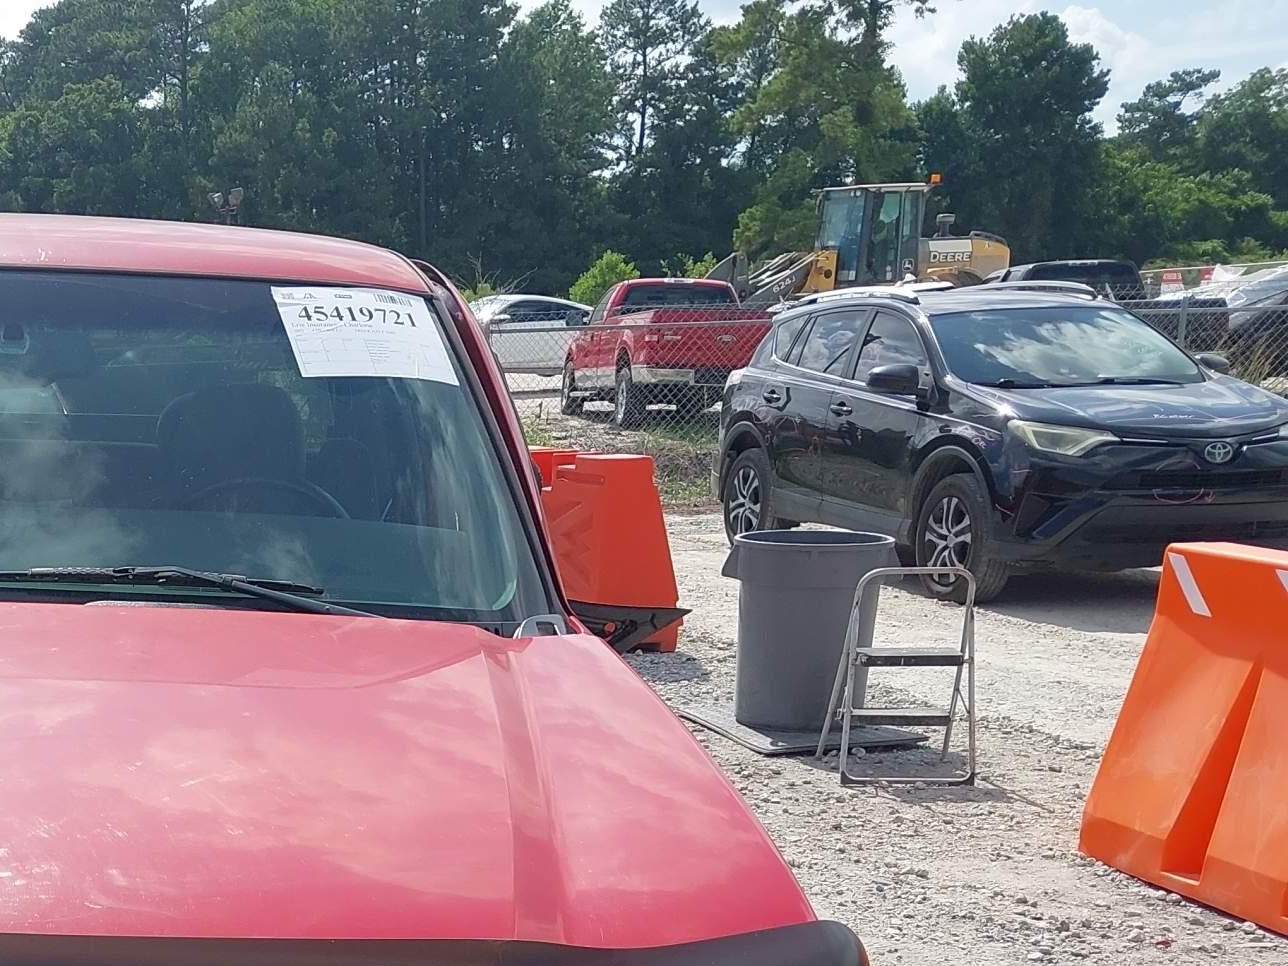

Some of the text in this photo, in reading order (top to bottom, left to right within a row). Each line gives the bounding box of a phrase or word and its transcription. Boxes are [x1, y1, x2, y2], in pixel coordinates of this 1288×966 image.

[929, 251, 972, 263] DEERE
[772, 274, 796, 293] 624J
[298, 305, 417, 328] 45419721
